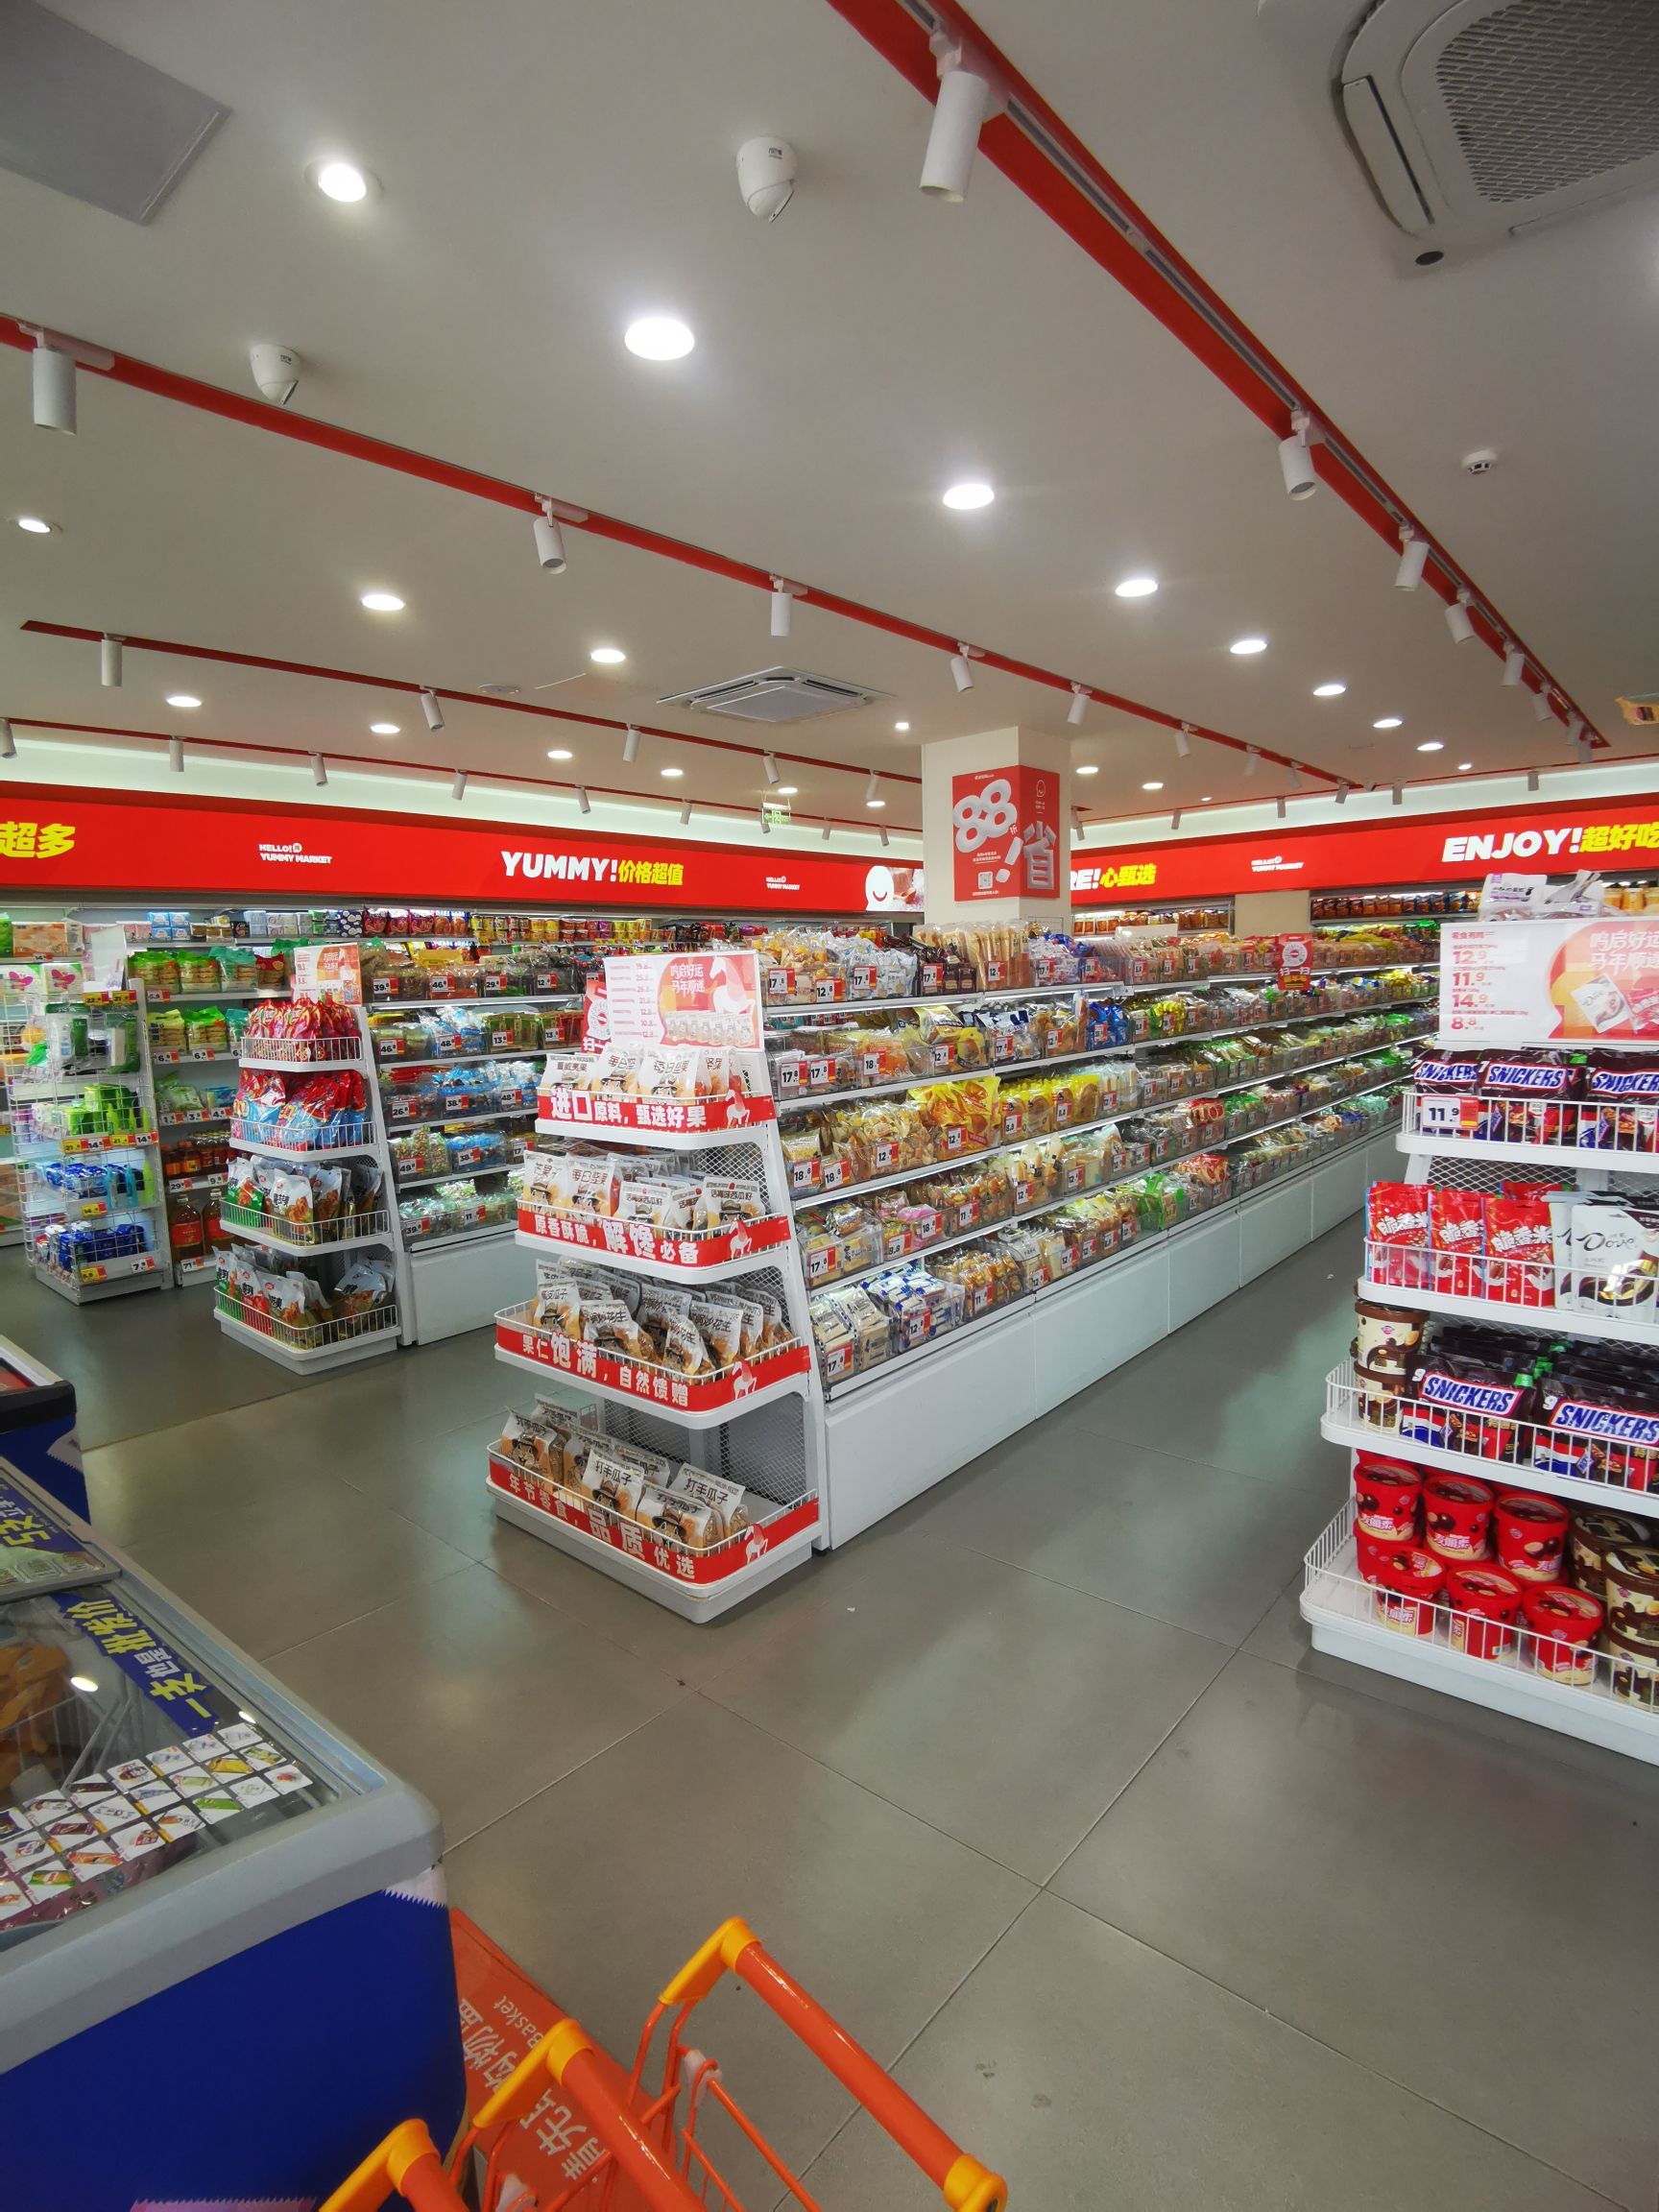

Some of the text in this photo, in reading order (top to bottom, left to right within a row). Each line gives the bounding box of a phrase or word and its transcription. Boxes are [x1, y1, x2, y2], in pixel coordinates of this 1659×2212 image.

[0, 821, 75, 858] 超多
[258, 844, 293, 854] HELLO!
[1442, 821, 1659, 863] ENJOY! 超好吃
[260, 853, 332, 864] YUMMY MARKET
[501, 851, 684, 886] YUMMY! 价格超值
[1100, 863, 1157, 889] 心甄选
[817, 986, 832, 997] 12.8
[782, 1070, 798, 1082] 17.8
[811, 1066, 827, 1078] 17.8
[1488, 1066, 1566, 1088] SNICKERS
[1429, 1107, 1459, 1122] 11.9
[795, 1168, 810, 1181] 18.8
[1377, 1212, 1429, 1236] 脆香米
[1493, 1225, 1553, 1252] 脆香米
[1424, 1376, 1515, 1414] SNICKERS
[1555, 1405, 1659, 1442] SNICKERS
[683, 1478, 729, 1504] 打手瓜子
[67, 1599, 212, 1719] 一支也是批发价
[493, 1996, 544, 2050] Basket
